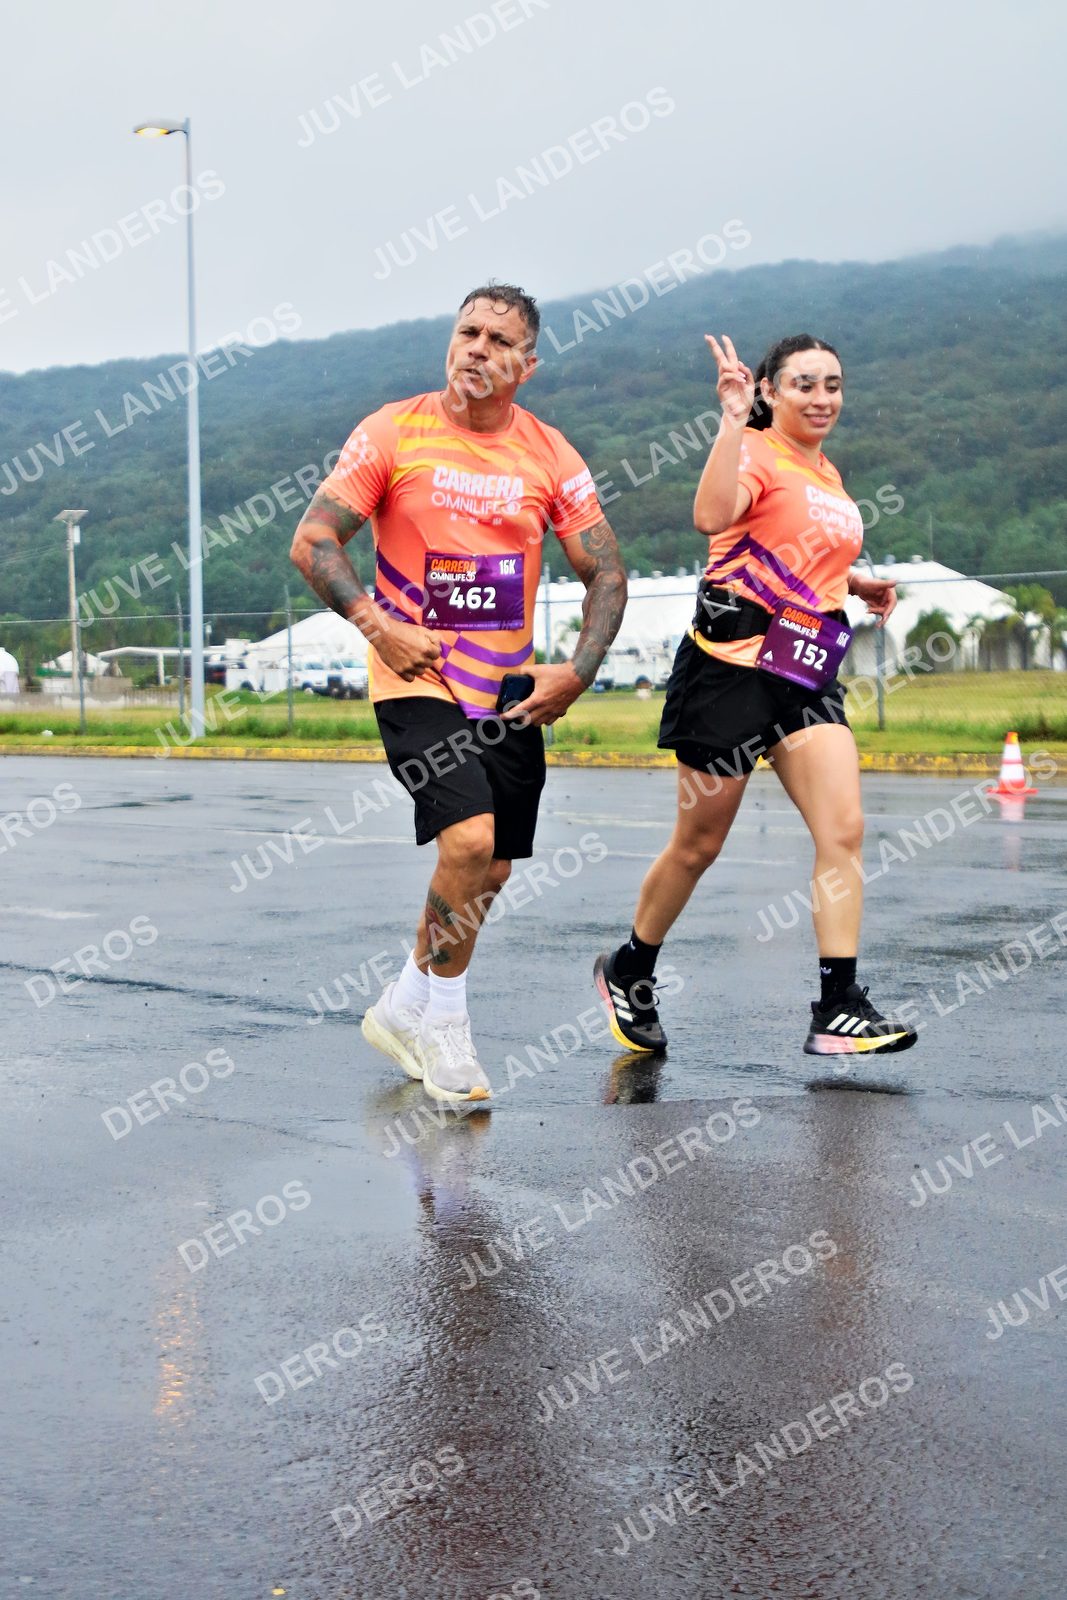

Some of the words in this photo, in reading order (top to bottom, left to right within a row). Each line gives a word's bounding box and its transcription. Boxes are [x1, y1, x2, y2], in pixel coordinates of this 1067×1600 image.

[432, 464, 524, 497] CARRERA
[431, 558, 476, 573] CARRERA
[448, 586, 496, 610] 462
[782, 606, 822, 631] CARRERA
[793, 639, 828, 671] 152
